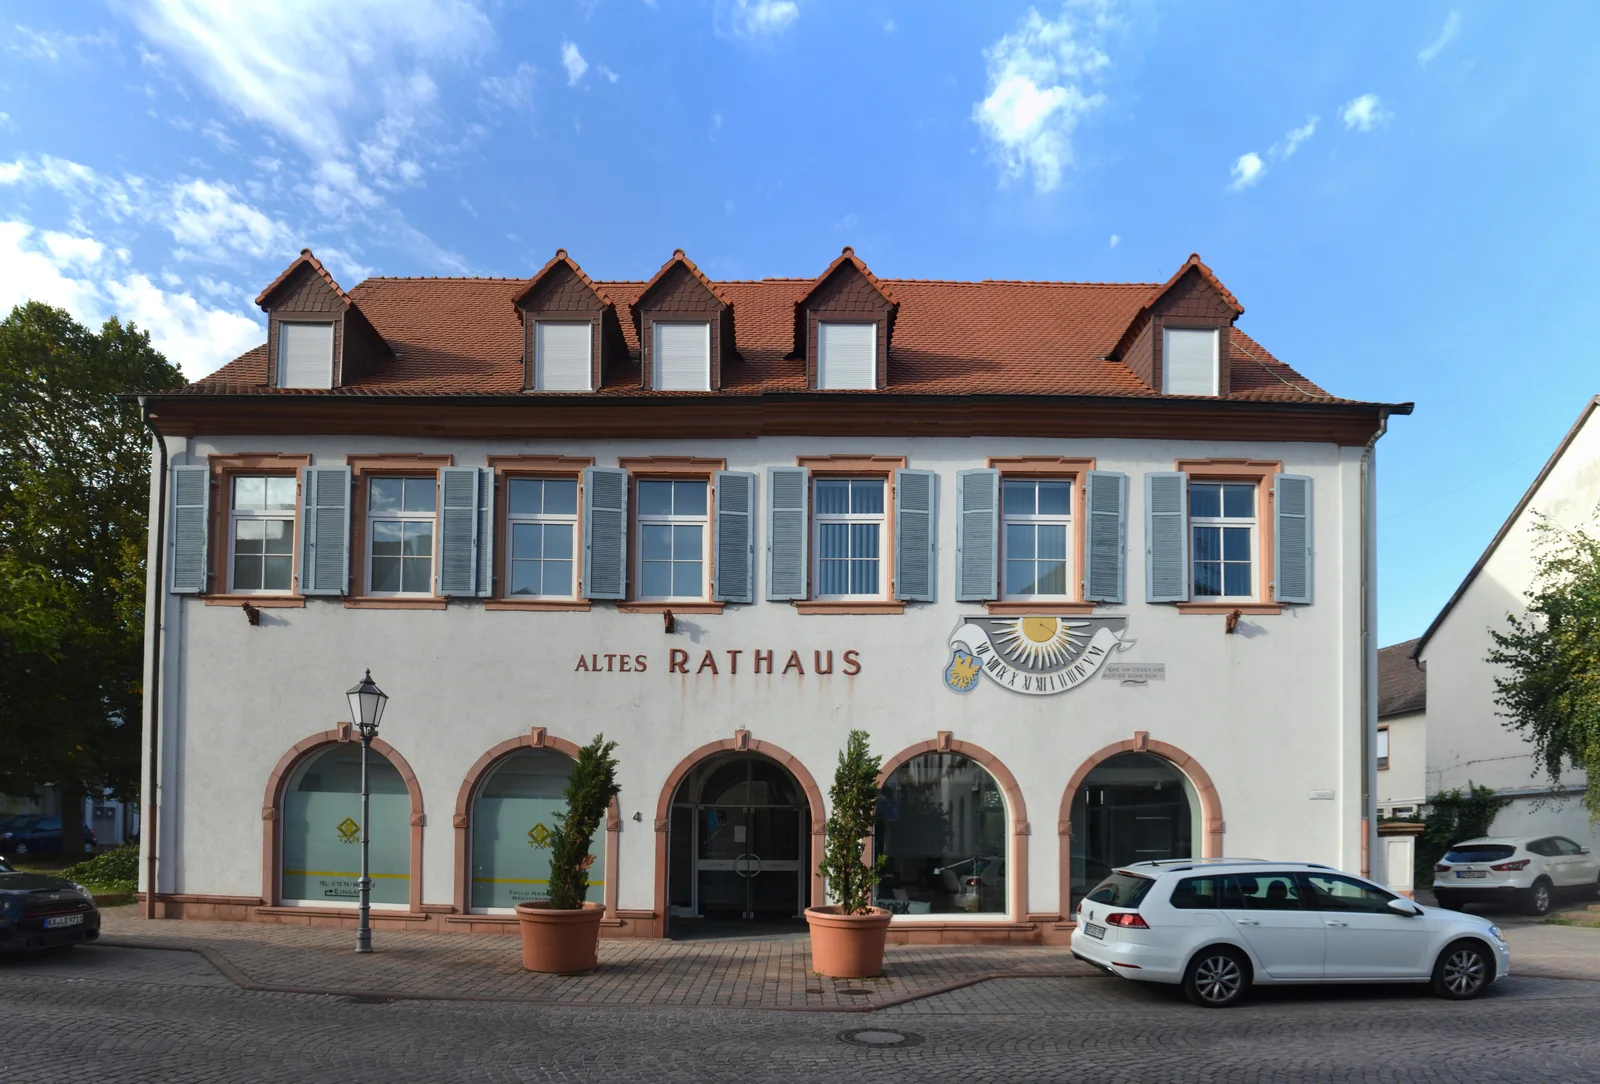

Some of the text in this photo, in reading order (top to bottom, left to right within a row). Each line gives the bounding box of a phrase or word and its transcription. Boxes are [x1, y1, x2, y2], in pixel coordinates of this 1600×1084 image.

[574, 648, 861, 675] ALTES RATHAUS
[975, 641, 1104, 691] VII VIII IX X XI XII I II III IV V VI
[632, 811, 643, 822] 4
